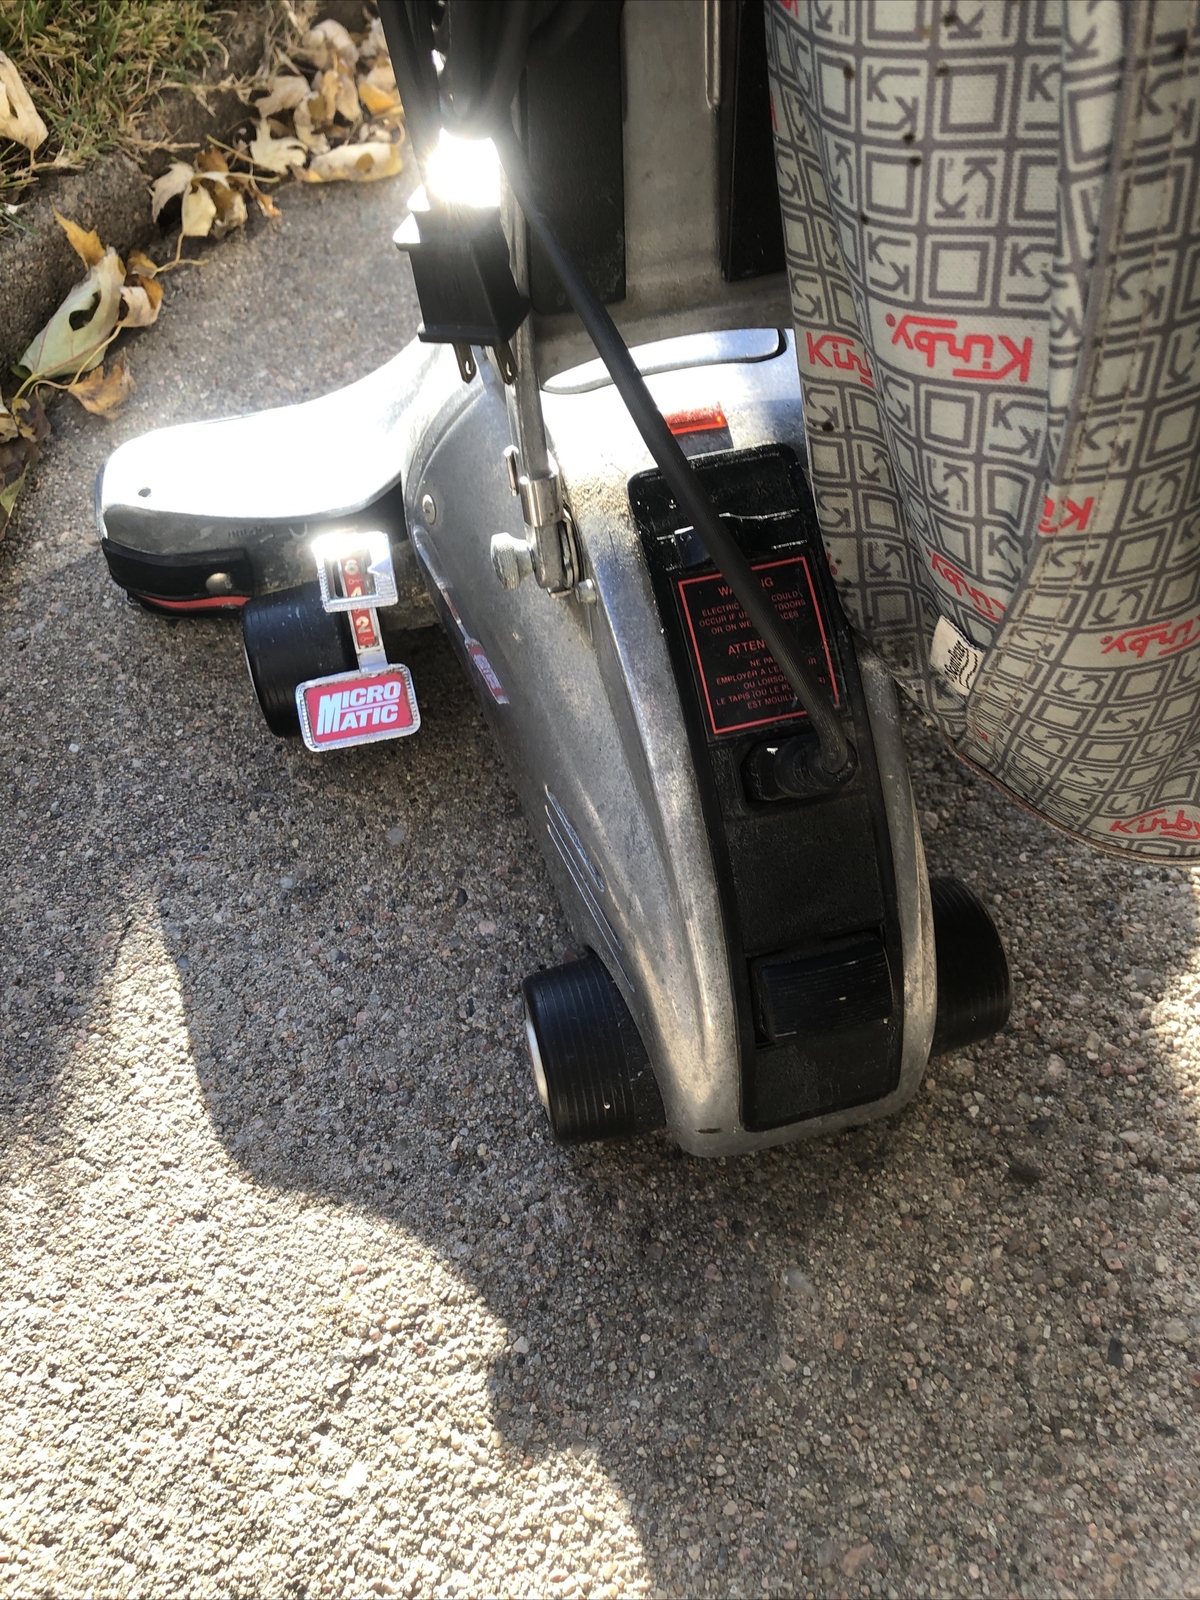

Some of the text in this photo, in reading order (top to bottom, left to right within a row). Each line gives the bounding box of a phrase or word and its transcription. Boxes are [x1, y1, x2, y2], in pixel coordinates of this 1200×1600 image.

[891, 314, 1034, 382] Kirby
[701, 602, 740, 617] ELECTRIC
[771, 590, 799, 602] COULD
[699, 614, 727, 627] OCCUR
[728, 612, 736, 622] IF
[774, 598, 807, 611] DOORS
[355, 615, 372, 634] 2
[711, 620, 753, 635] OR ON WE
[728, 639, 766, 655] ATTEN
[750, 656, 775, 667] NE PA
[716, 669, 758, 685] EMPLOYER
[743, 681, 756, 690] OU
[715, 697, 726, 706] LE
[728, 691, 751, 703] TAPIS
[769, 685, 779, 694] LE
[316, 681, 402, 735] MICRO
[747, 702, 762, 710] EST
